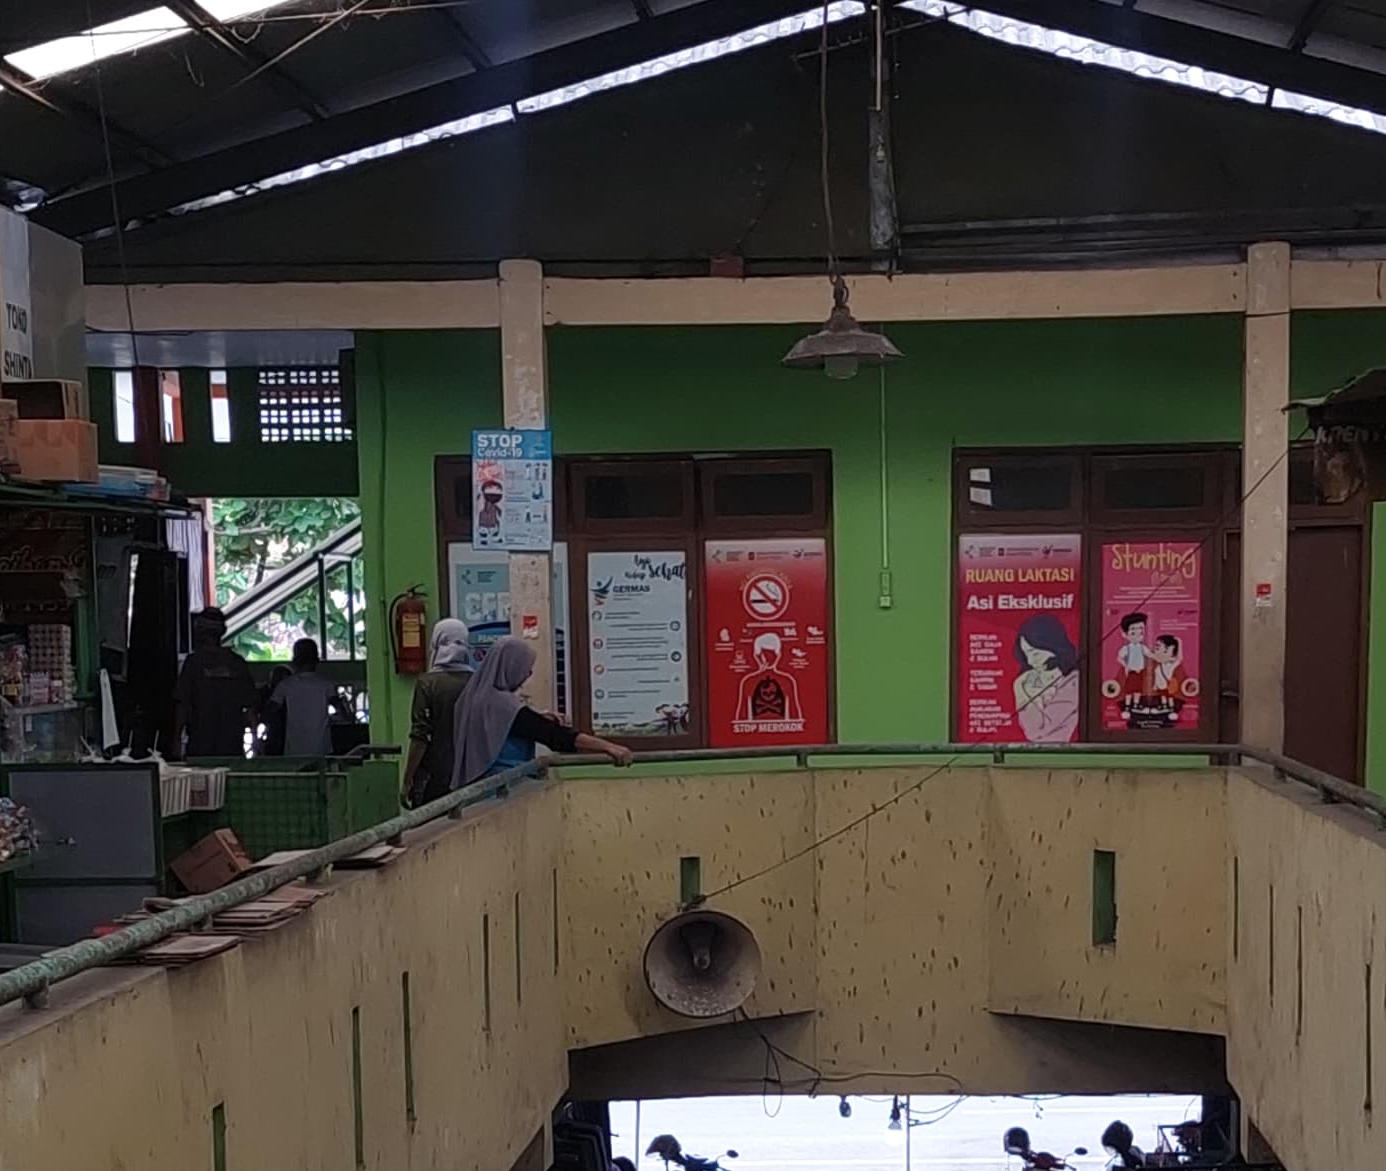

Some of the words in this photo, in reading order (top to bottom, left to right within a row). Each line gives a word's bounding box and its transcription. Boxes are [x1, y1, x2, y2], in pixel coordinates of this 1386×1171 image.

[5, 302, 28, 334] TOKO
[477, 433, 523, 448] STOP
[477, 447, 523, 458] Covid-19
[1112, 543, 1197, 579] Stunting
[965, 567, 1014, 584] RUANG
[1018, 567, 1075, 583] LAKTASI
[966, 594, 994, 610] Asi
[997, 593, 1075, 609] Eksklusif
[733, 723, 757, 734] STOP
